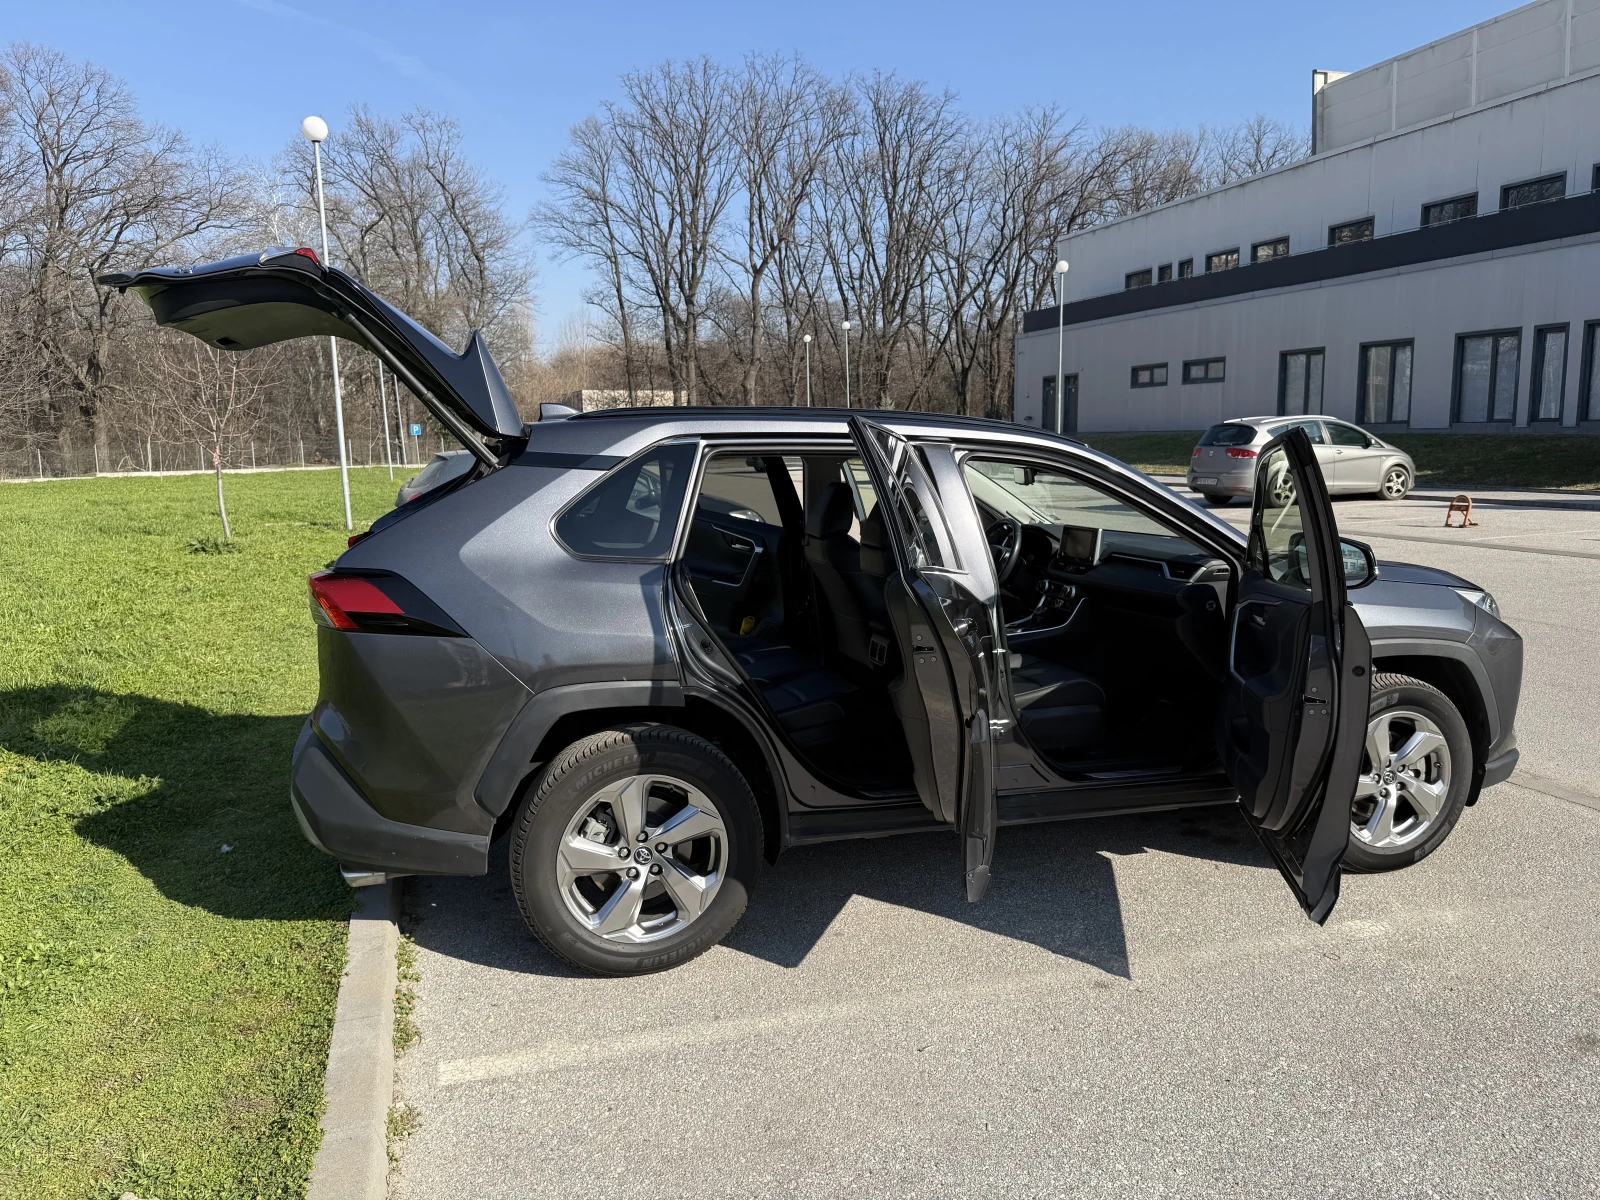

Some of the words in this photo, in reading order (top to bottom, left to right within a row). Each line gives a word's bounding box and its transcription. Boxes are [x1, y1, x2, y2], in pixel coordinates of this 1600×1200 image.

[413, 425, 419, 434] P
[575, 752, 651, 789] MICHELIN
[641, 928, 714, 968] MICHELIN
